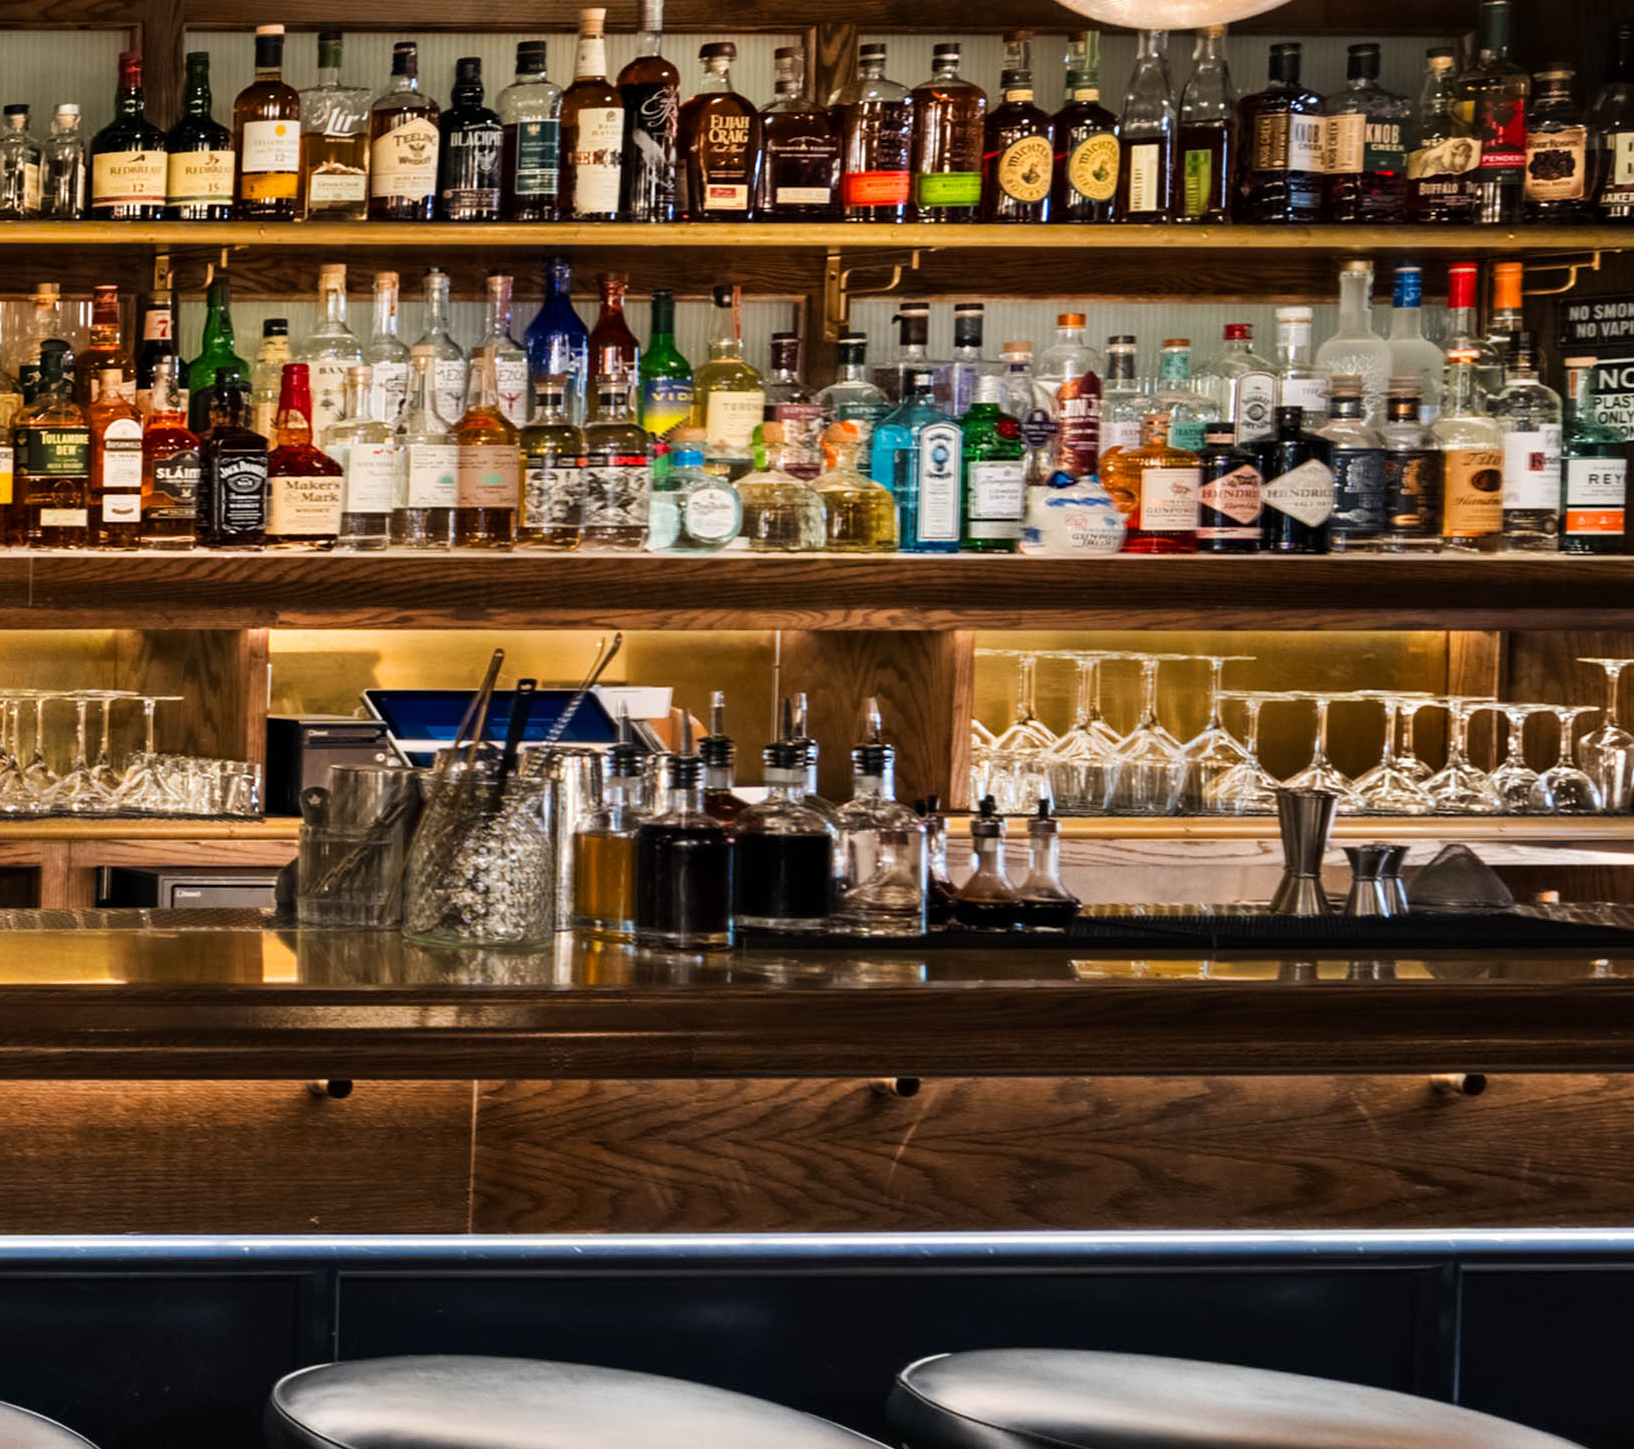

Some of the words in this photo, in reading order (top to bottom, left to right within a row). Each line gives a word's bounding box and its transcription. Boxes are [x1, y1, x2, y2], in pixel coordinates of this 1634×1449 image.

[710, 114, 749, 129] ELIJAH
[709, 128, 749, 144] CRAIG
[1294, 123, 1322, 143] KNOB
[1366, 123, 1401, 144] KNOB
[132, 183, 145, 193] 12
[208, 183, 220, 193] 15
[1418, 182, 1459, 195] BUFFALO
[1569, 306, 1590, 320] NO
[1594, 304, 1634, 319] SMOK
[158, 319, 168, 338] 7
[1576, 323, 1597, 337] NO
[1601, 321, 1634, 336] VAPI
[1593, 396, 1634, 408] PLAST
[41, 431, 90, 446] TULLAMORE
[56, 446, 76, 456] DEW
[284, 479, 341, 491] Maker's
[302, 492, 339, 503] Mark
